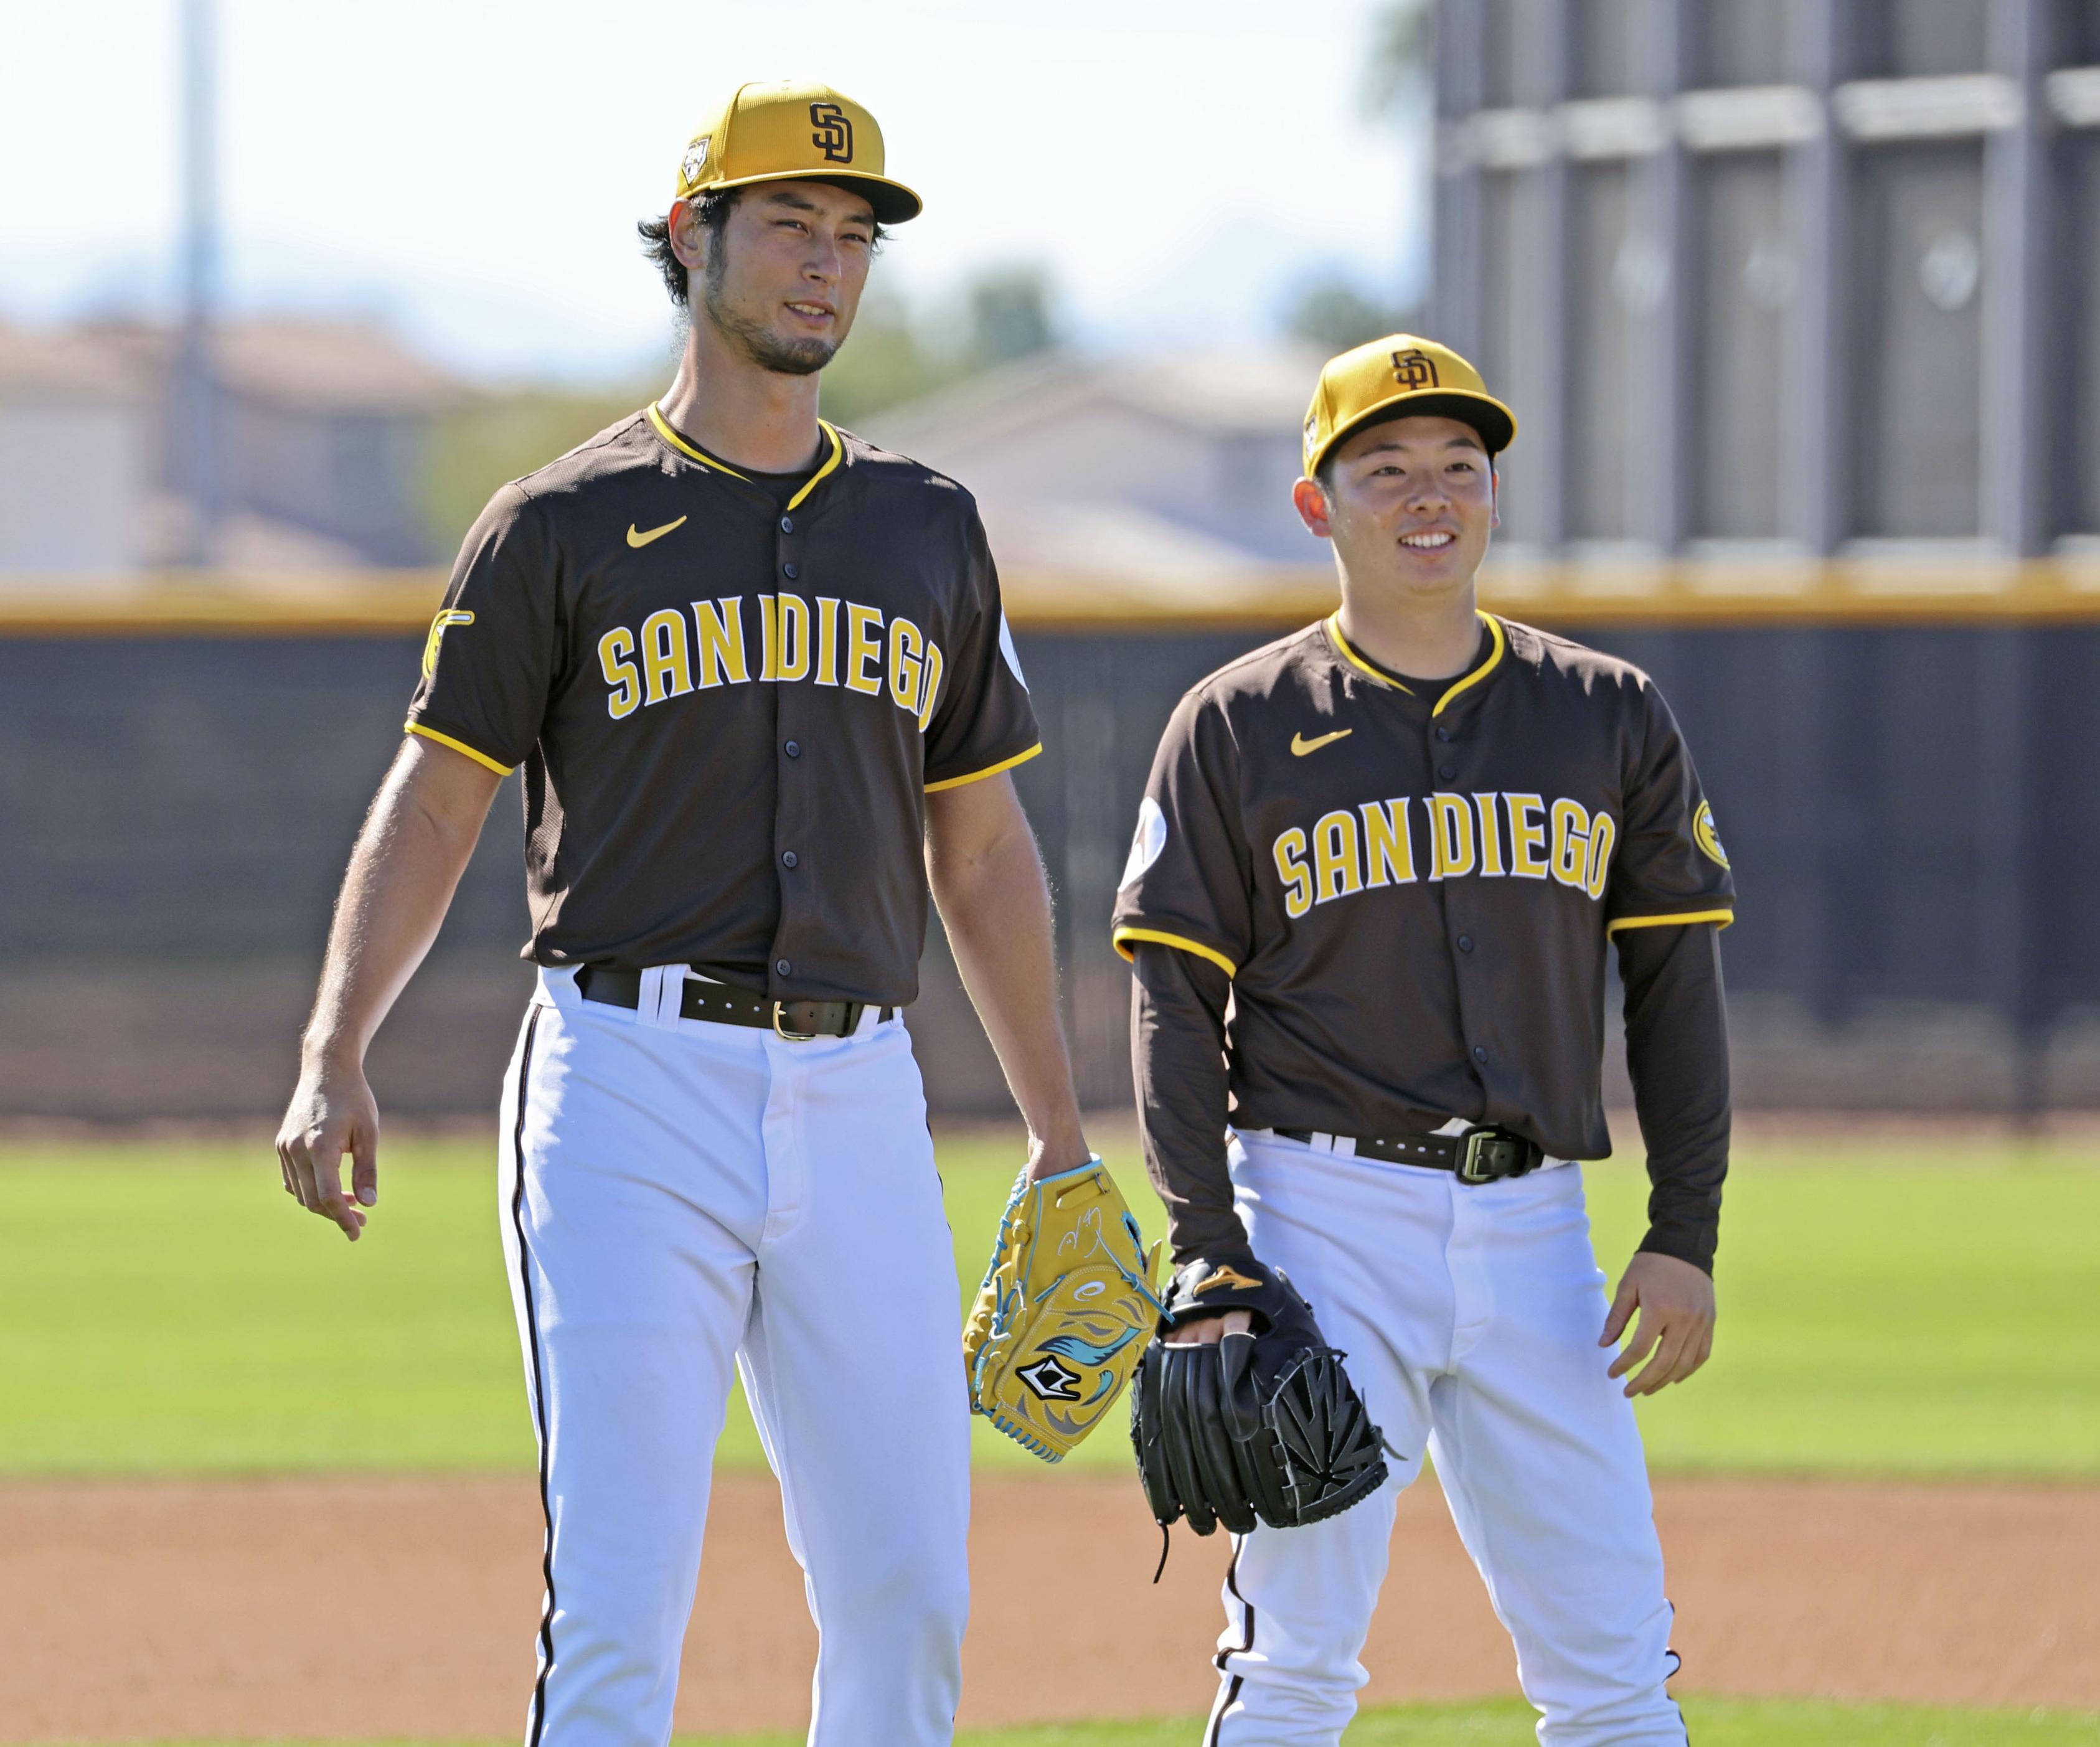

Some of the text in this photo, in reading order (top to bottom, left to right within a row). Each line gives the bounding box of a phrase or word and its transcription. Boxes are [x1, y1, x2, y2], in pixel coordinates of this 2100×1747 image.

[810, 102, 853, 163] SD
[1391, 348, 1439, 390] SD
[598, 592, 944, 733] SAN DIEGO
[1273, 791, 1616, 920] SAN DIEGO
